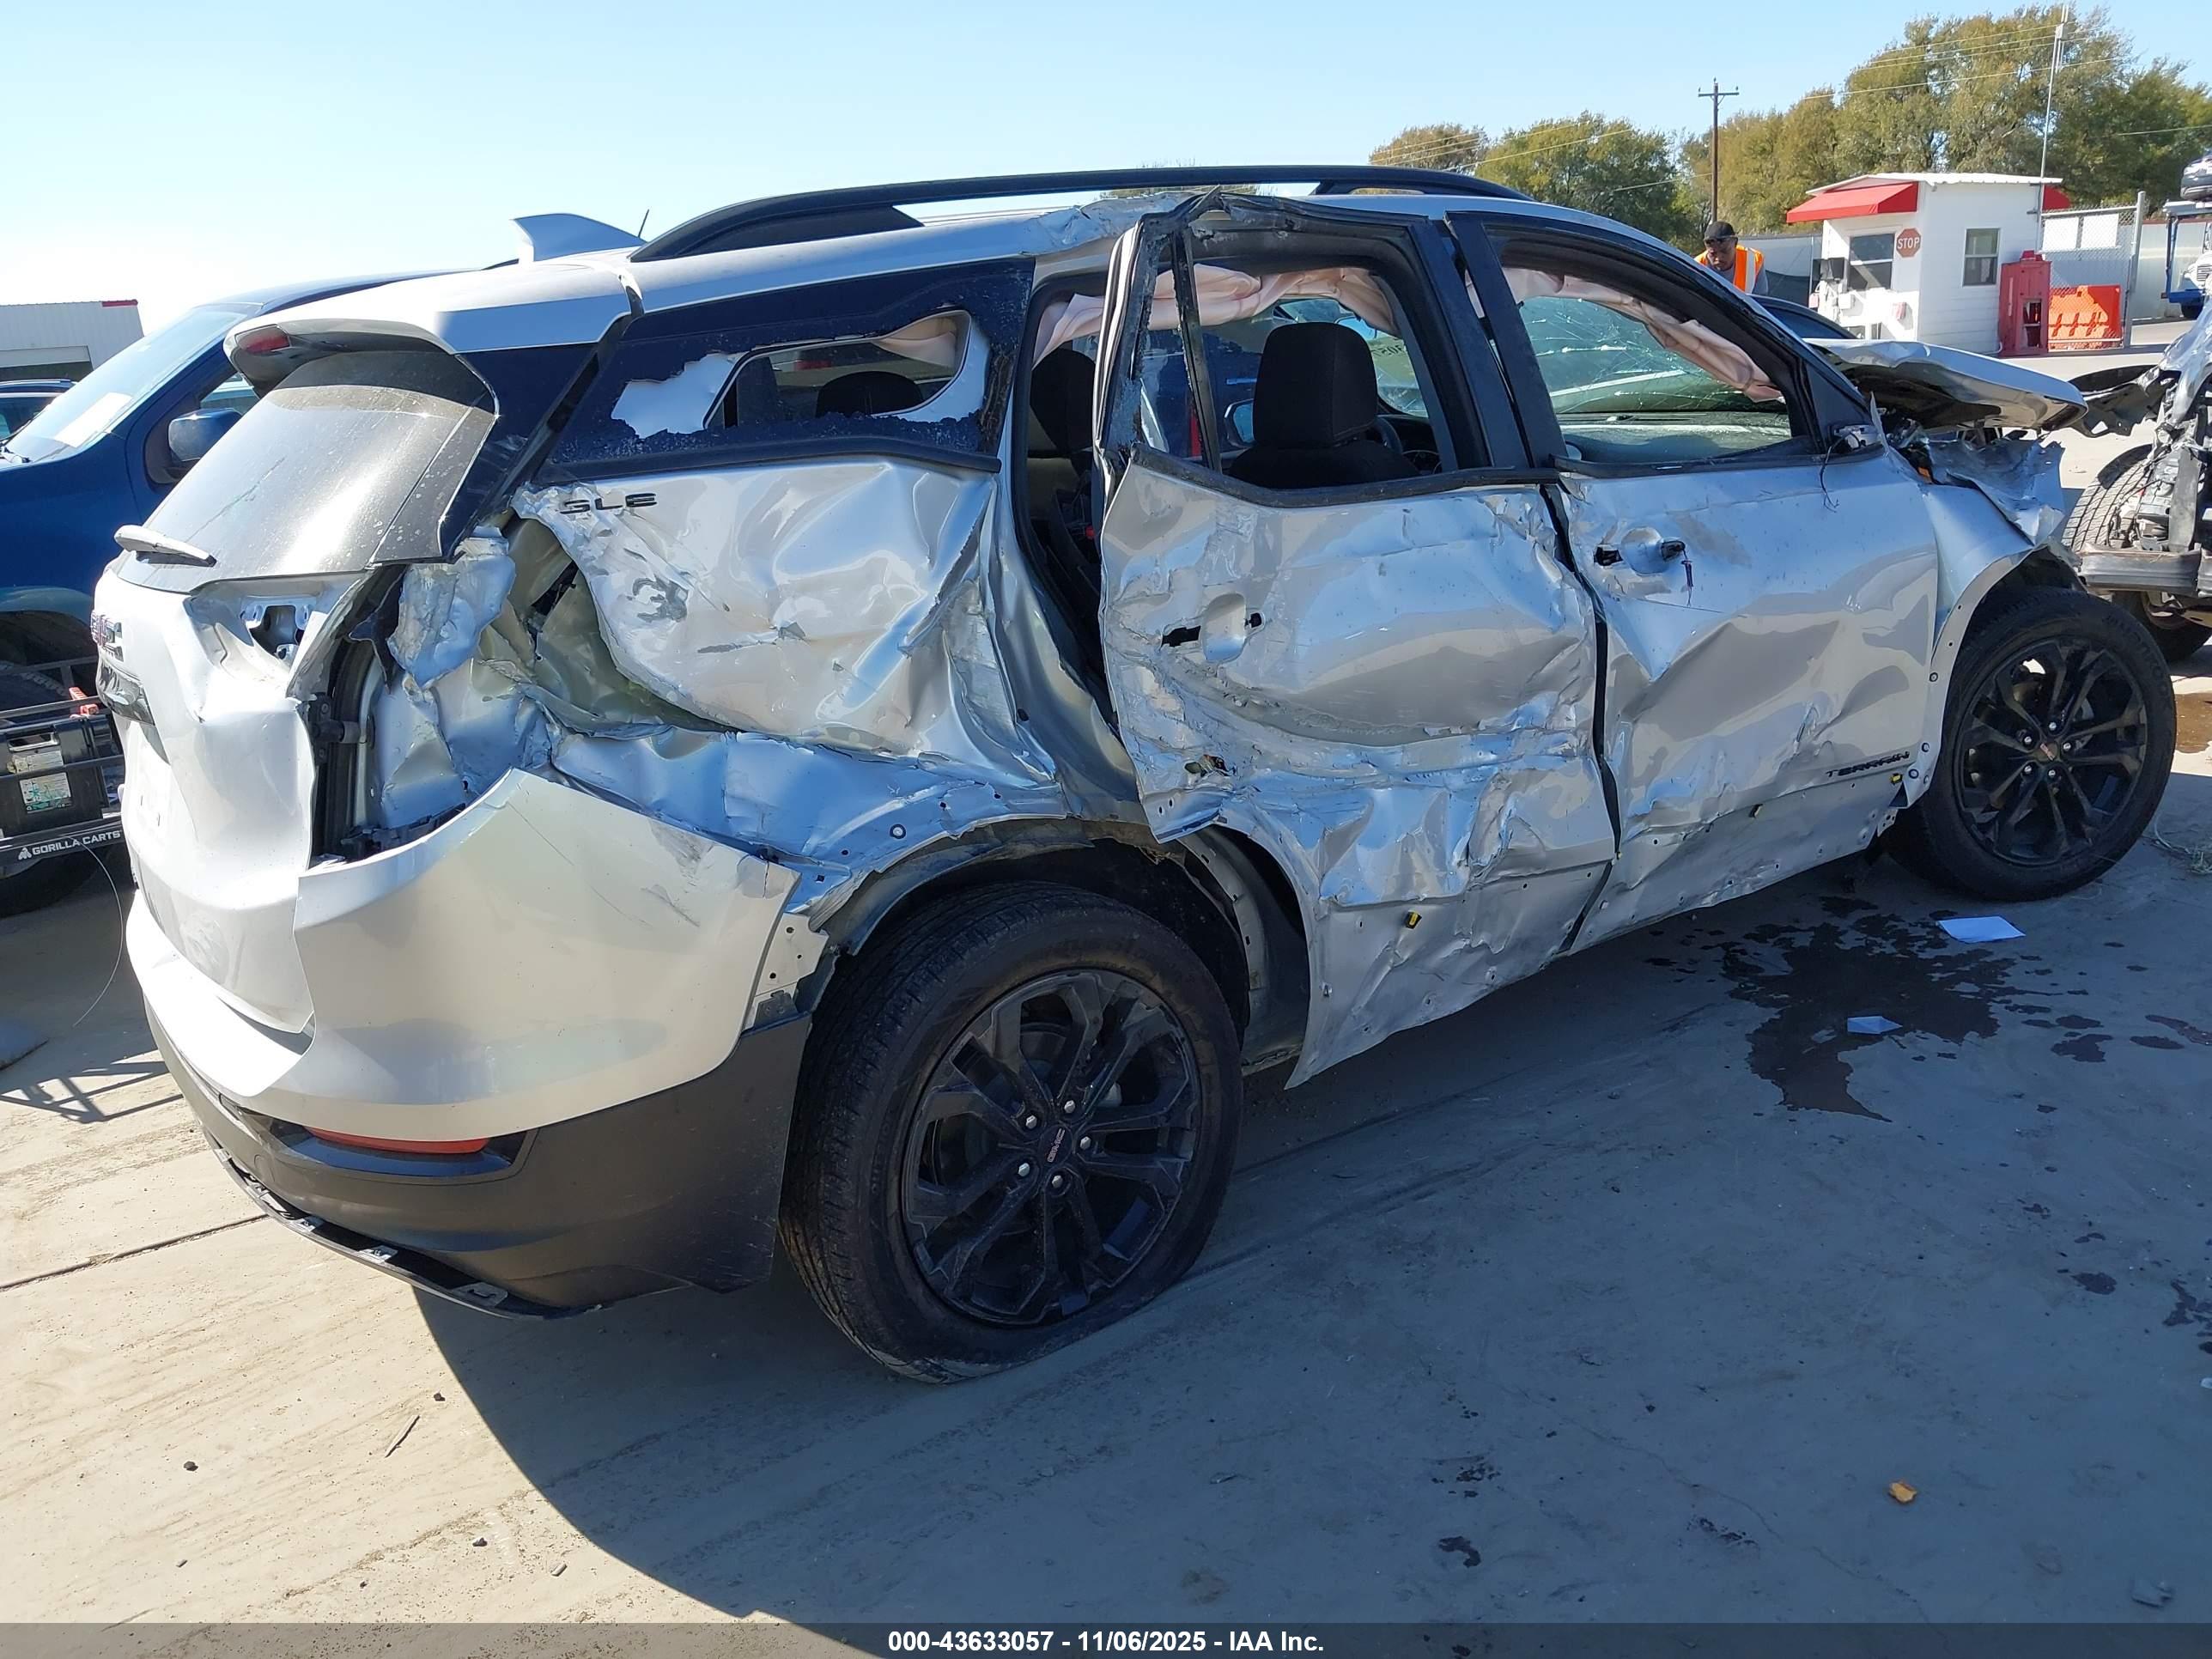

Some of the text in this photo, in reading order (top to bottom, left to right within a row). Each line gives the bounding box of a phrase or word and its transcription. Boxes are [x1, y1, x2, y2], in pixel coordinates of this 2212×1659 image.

[1897, 236, 1920, 249] STOP
[560, 492, 658, 514] SLE
[32, 830, 121, 855] GORILLA CARTS
